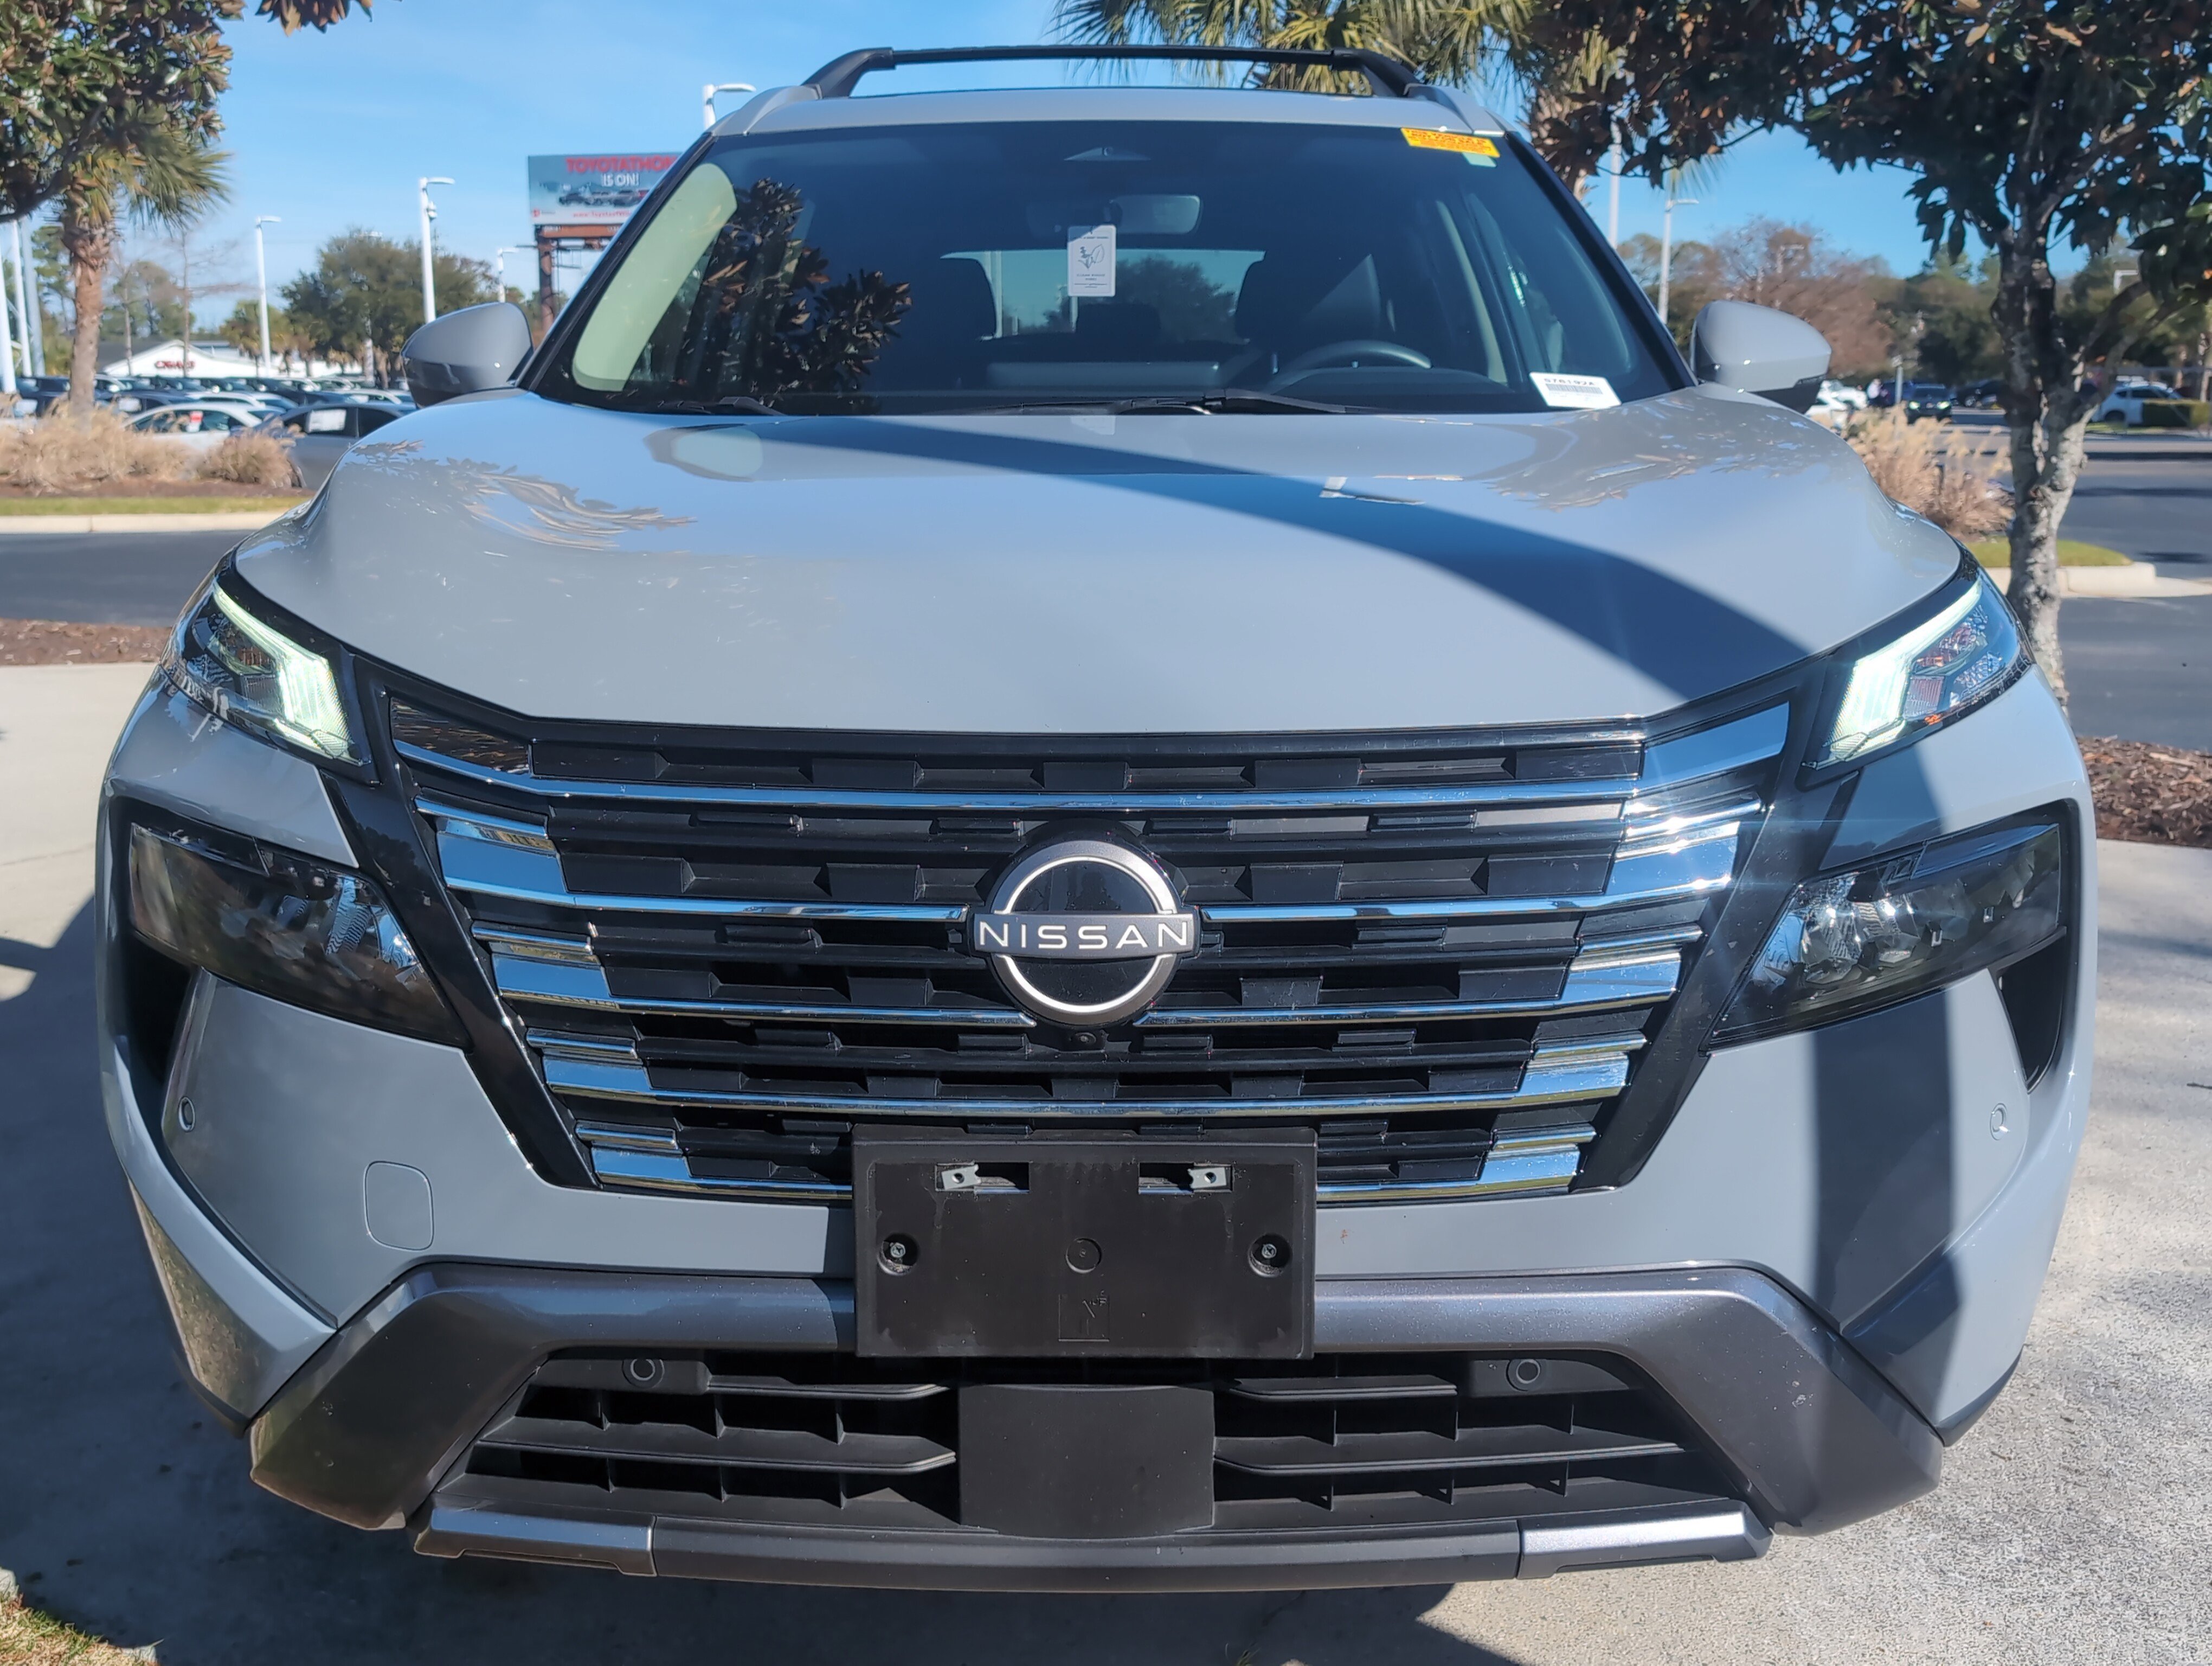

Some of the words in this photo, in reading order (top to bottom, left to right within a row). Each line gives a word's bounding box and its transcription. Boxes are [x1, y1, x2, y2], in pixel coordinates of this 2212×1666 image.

[566, 155, 677, 173] TOYOTATHON
[602, 173, 613, 187] IS
[616, 172, 640, 186] ON!
[979, 921, 1187, 950] NISSAN
